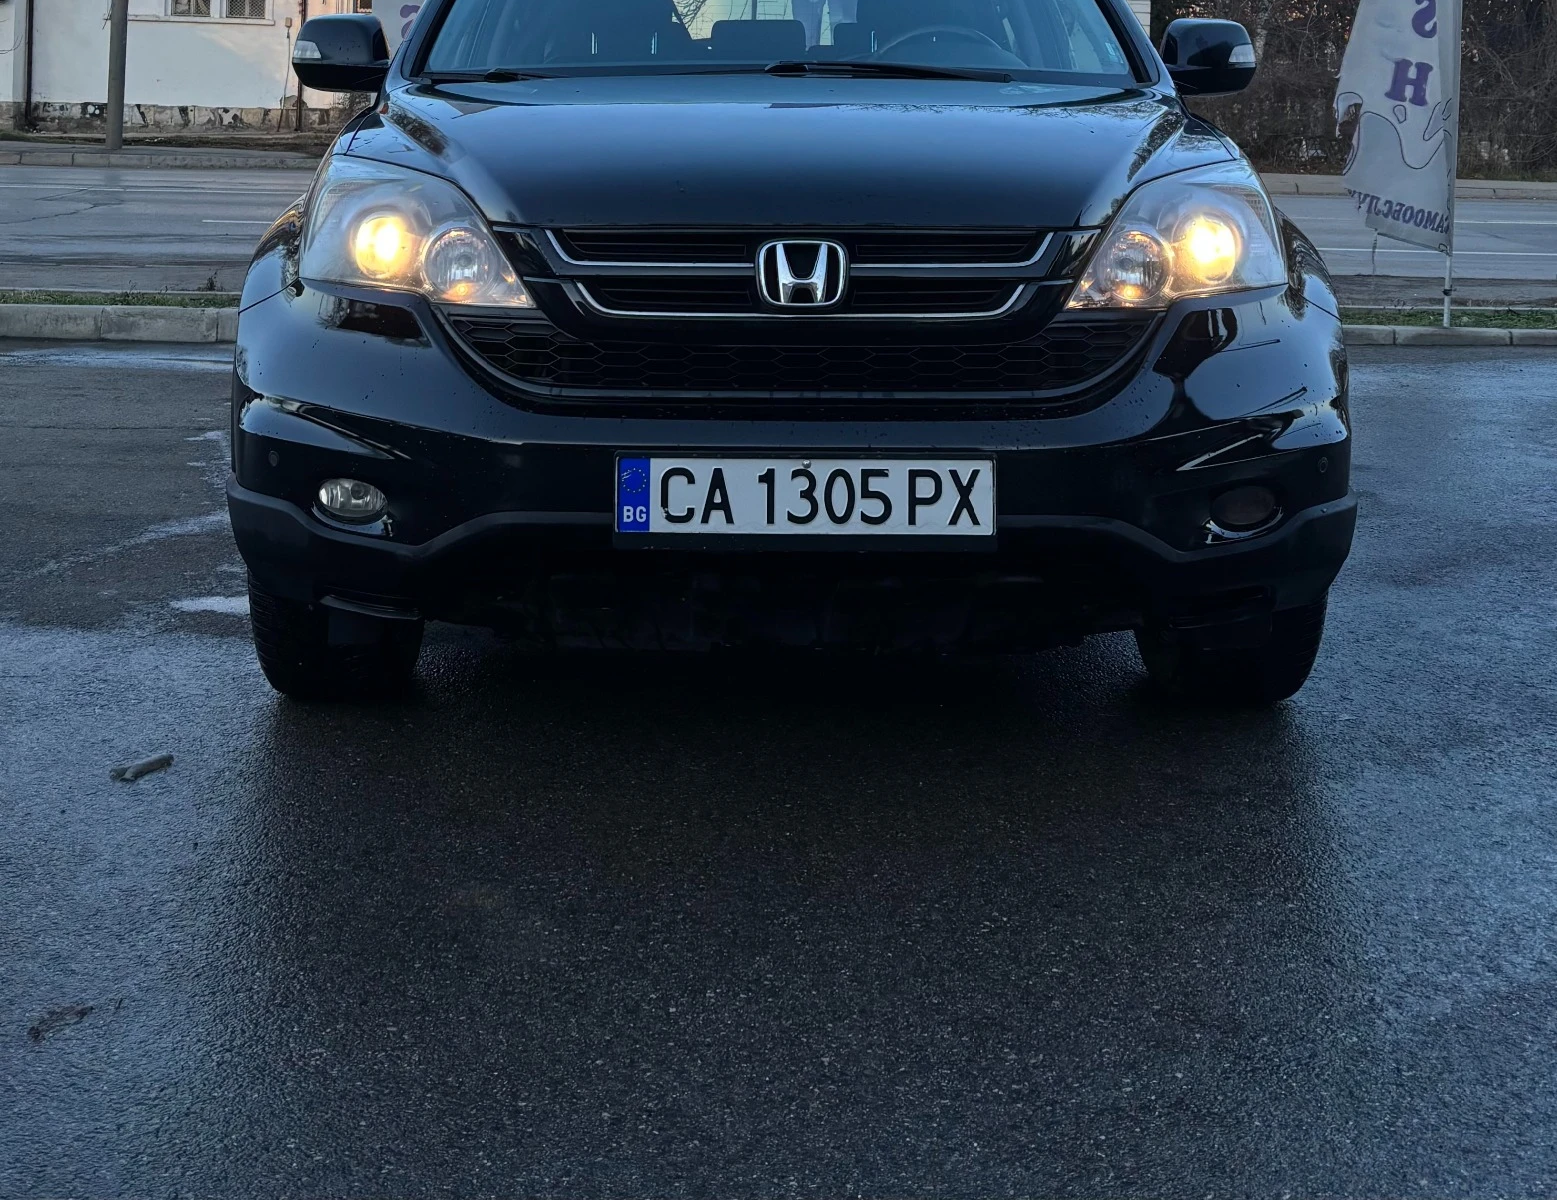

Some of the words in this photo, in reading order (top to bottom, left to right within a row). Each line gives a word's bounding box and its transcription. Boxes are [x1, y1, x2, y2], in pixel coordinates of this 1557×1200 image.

[622, 505, 648, 524] BG
[660, 467, 735, 525] CA
[757, 467, 893, 526] 1305
[907, 468, 982, 527] PX
